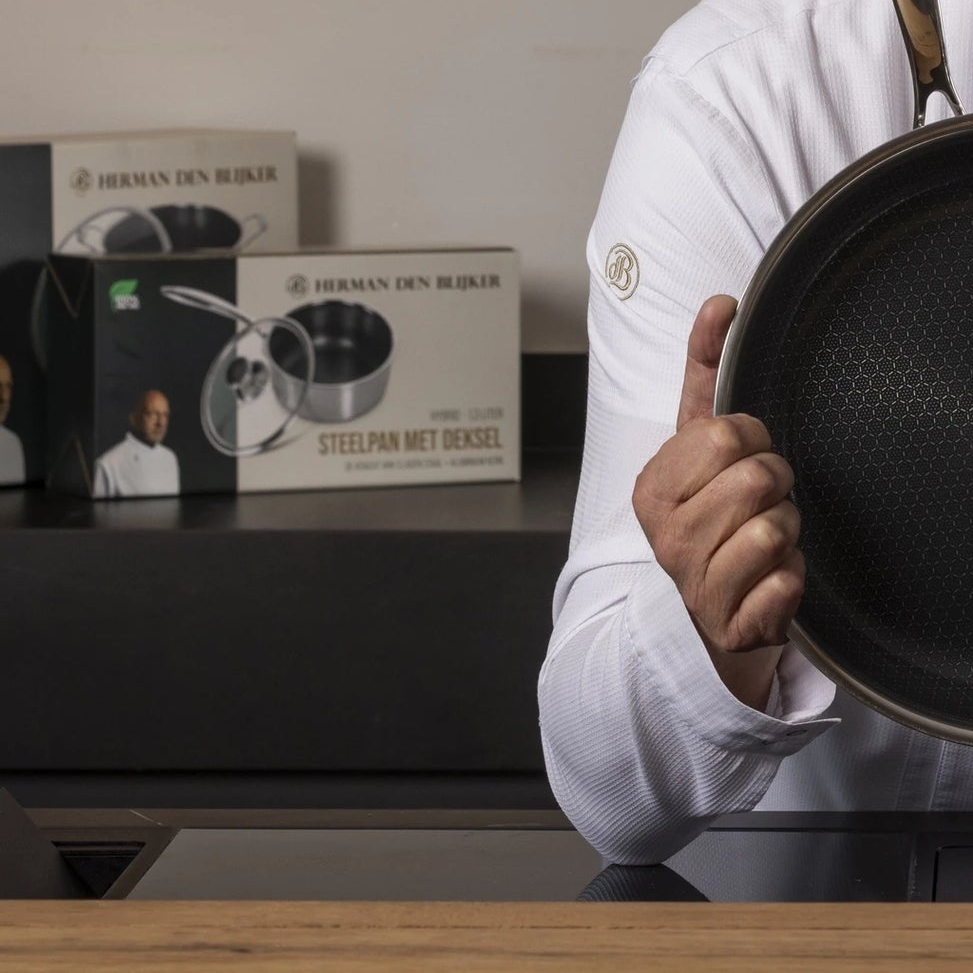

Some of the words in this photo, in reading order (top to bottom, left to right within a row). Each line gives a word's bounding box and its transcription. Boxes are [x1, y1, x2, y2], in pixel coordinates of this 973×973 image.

[98, 170, 170, 190] HERMAN
[175, 168, 210, 187] DEN
[215, 166, 278, 186] BLIJKER
[315, 277, 389, 293] HERMAN
[395, 275, 431, 292] DEN
[436, 274, 501, 292] BLIJKER
[318, 430, 400, 456] STEELPAN
[404, 429, 439, 452] MET
[443, 427, 504, 450] DEKSEL
